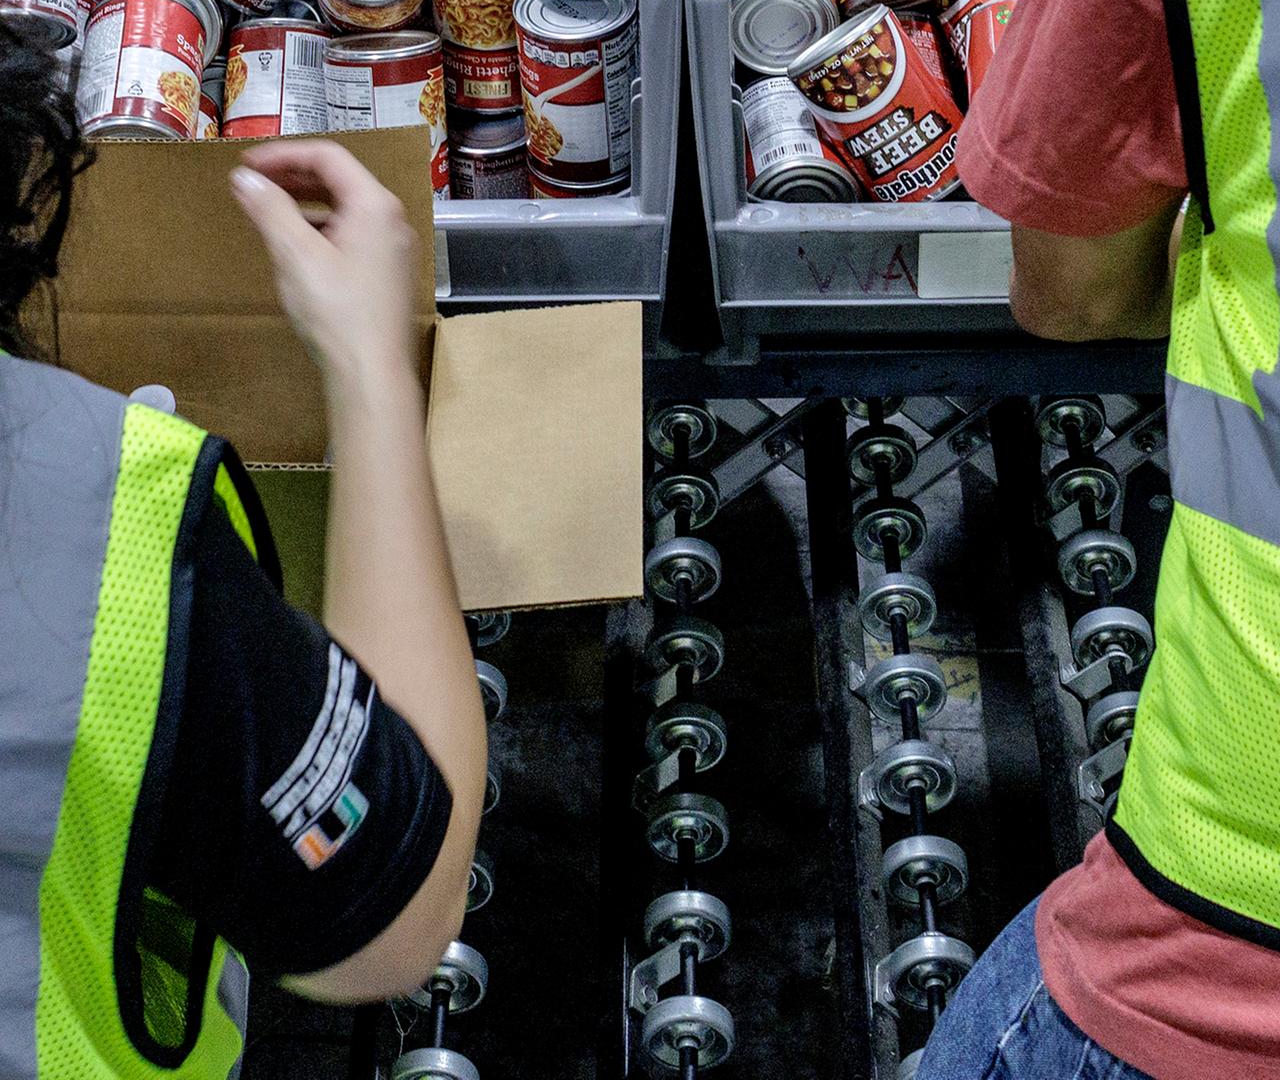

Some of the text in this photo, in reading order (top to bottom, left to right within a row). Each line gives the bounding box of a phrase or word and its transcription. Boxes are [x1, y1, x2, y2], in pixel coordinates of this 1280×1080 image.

[477, 63, 516, 77] ghetti
[468, 82, 508, 95] FINEST
[850, 109, 910, 157] STEW
[871, 112, 943, 176] BEEF
